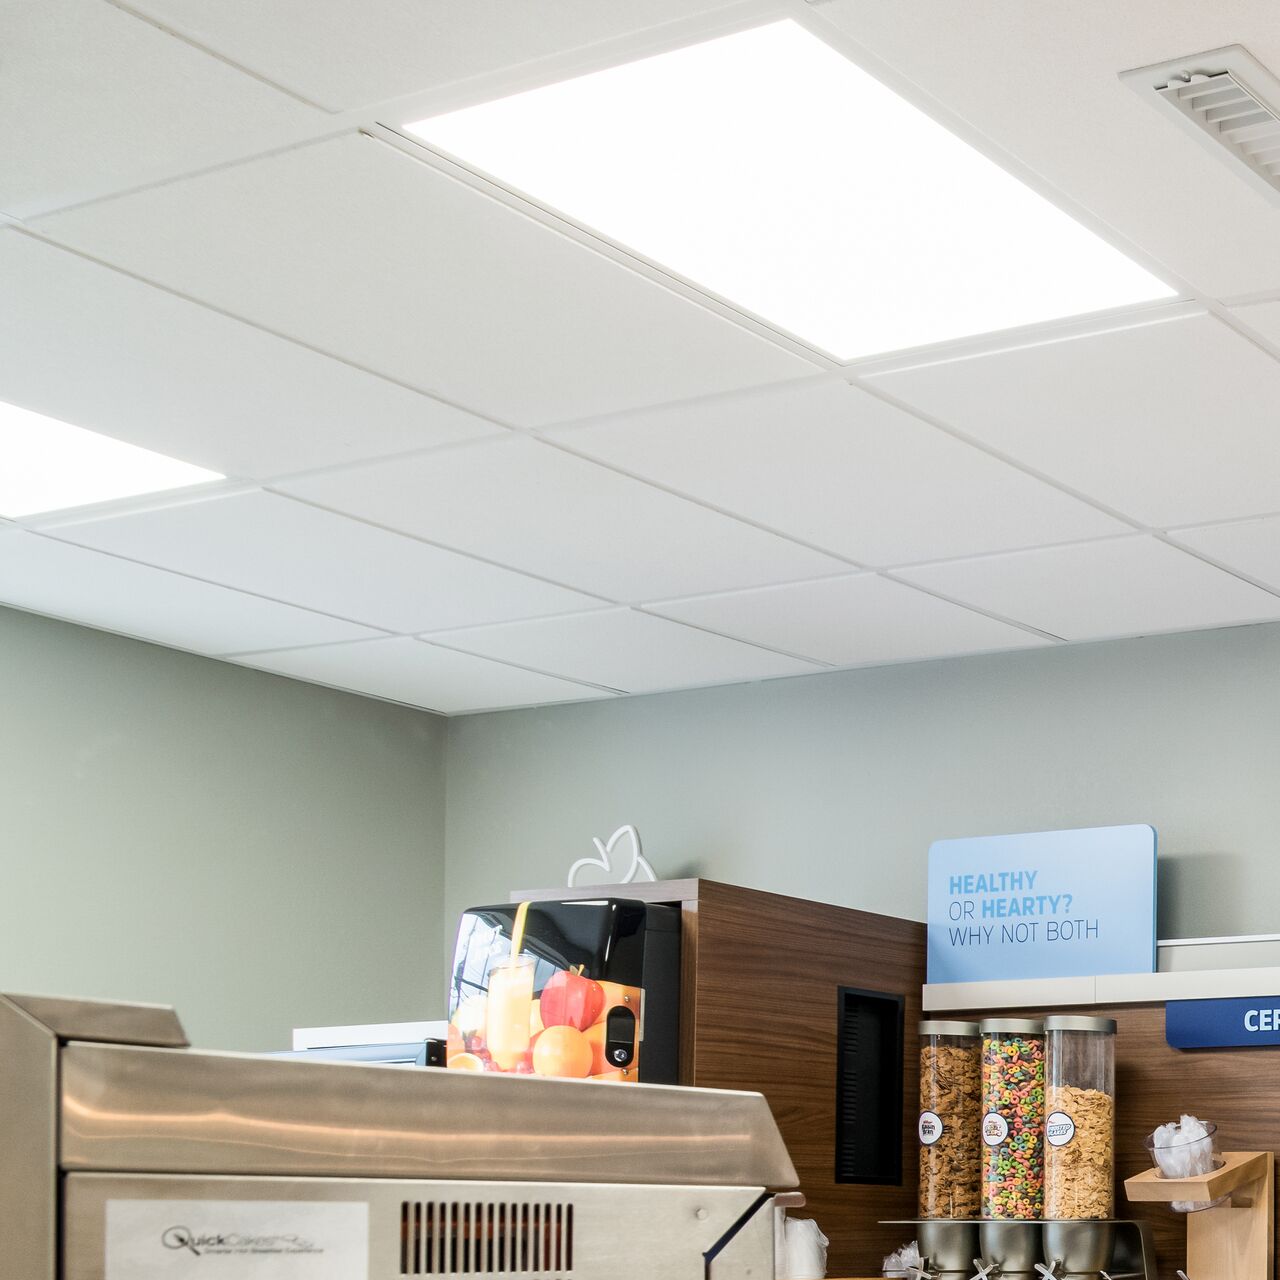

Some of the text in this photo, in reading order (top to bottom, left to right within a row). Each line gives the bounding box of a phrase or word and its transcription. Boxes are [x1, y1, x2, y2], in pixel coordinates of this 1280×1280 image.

[949, 870, 1038, 895] HEALTHY
[949, 894, 1073, 921] OR HEARTY?
[949, 919, 1099, 947] WHY NOT BOTH
